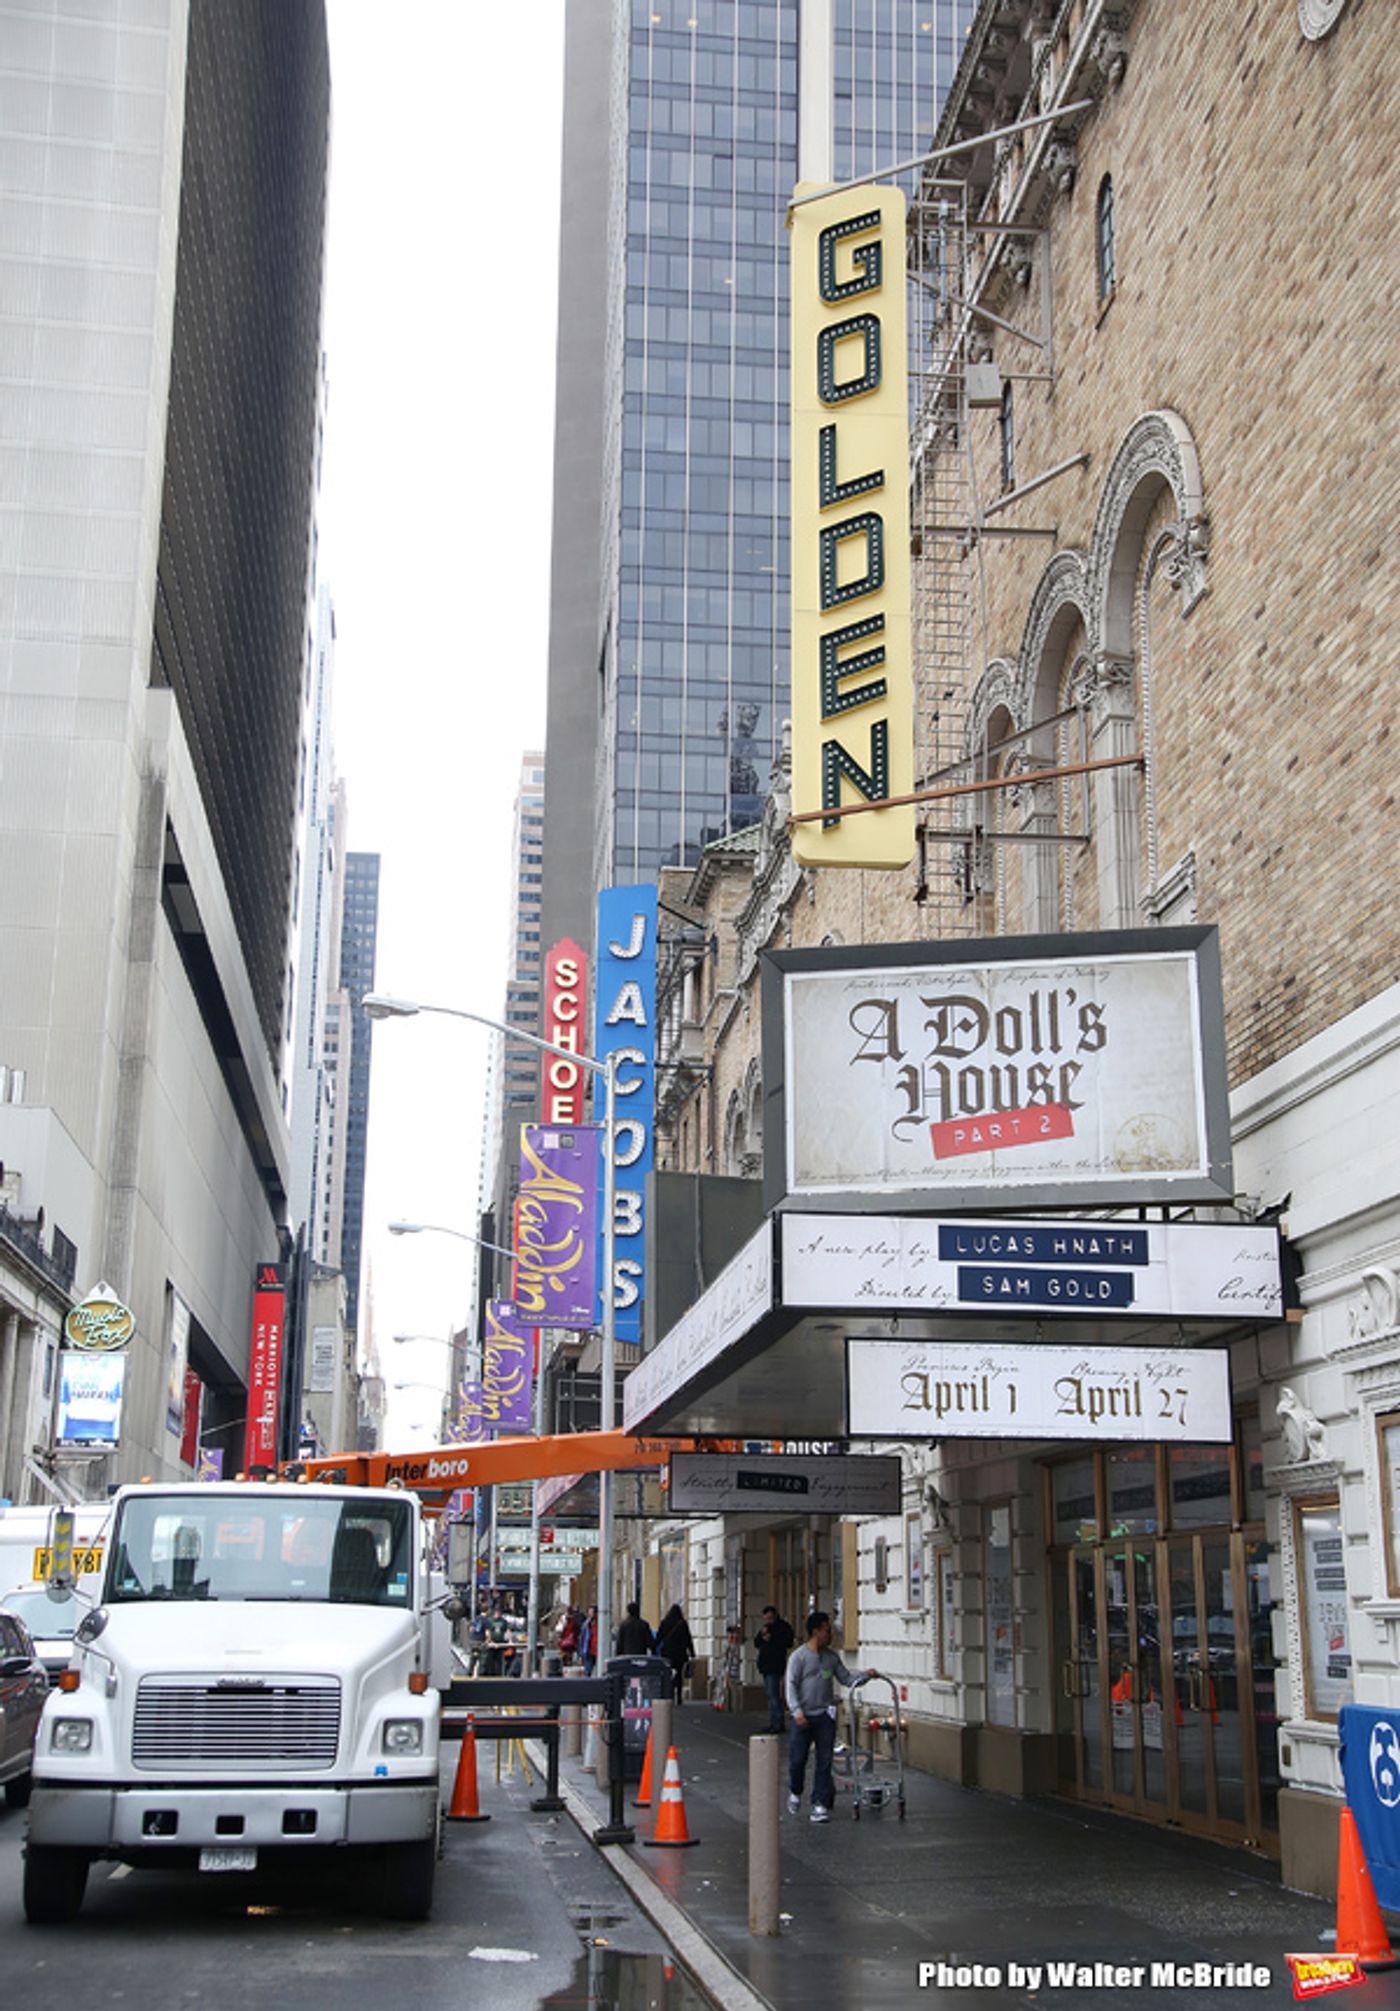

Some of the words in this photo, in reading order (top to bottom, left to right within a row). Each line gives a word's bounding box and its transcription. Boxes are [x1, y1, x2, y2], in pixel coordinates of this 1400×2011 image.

[817, 209, 889, 830] GOLDEN
[550, 958, 578, 1124] SCHOE
[849, 998, 906, 1066] A
[919, 987, 1108, 1060] Doll's
[600, 913, 647, 1309] JACOBS
[891, 1059, 1086, 1143] House
[953, 1119, 1021, 1147] PART
[1039, 1115, 1053, 1134] 2
[518, 1123, 584, 1311] Aladdin
[798, 1235, 824, 1253] A
[859, 1241, 901, 1268] play
[956, 1235, 1034, 1255] LUCAS
[1053, 1237, 1134, 1255] HNATH
[855, 1279, 926, 1299] Directed
[982, 1275, 1031, 1295] SAM
[1048, 1277, 1112, 1299] GOLD
[73, 1306, 127, 1327] Music
[82, 1324, 129, 1345] Box
[257, 1324, 266, 1351] NEW
[254, 1357, 265, 1386] YORK
[266, 1324, 278, 1387] MARRIOTT
[482, 1298, 526, 1420] Aladdin
[974, 1357, 1020, 1380] Begin
[900, 1371, 989, 1420] April
[1007, 1383, 1017, 1414] 1
[1054, 1376, 1142, 1425] April
[1158, 1388, 1189, 1426] 27
[385, 1458, 469, 1483] Interboro
[680, 1474, 734, 1498] Strictly
[743, 1477, 802, 1490] LIMITED
[809, 1475, 888, 1498] Engagement
